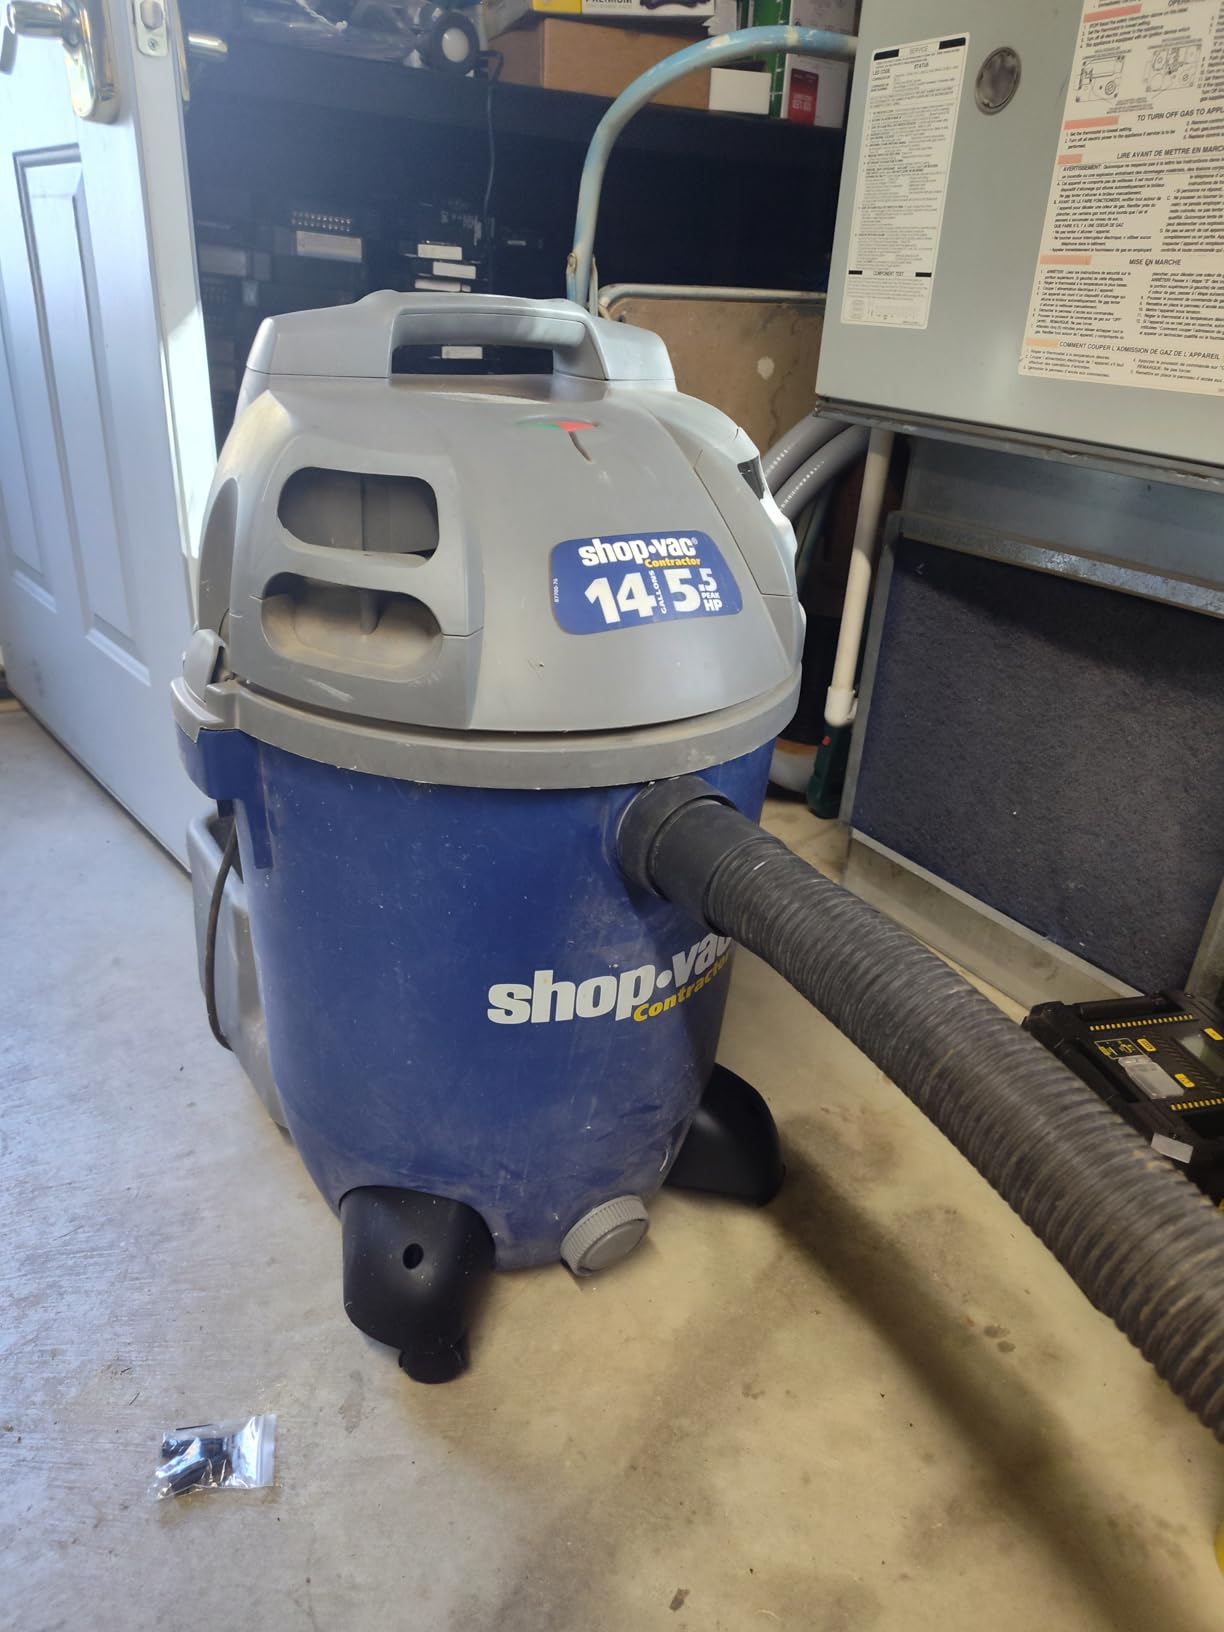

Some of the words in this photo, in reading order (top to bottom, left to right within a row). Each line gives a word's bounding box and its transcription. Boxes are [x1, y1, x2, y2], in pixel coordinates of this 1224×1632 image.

[1137, 113, 1146, 122] TO
[1147, 112, 1165, 121] TURN
[1166, 110, 1179, 119] OFF
[1180, 109, 1194, 118] GAS
[1195, 108, 1206, 116] TO
[1117, 151, 1130, 160] LIRE
[1131, 150, 1153, 159] AVANT
[1154, 149, 1163, 157] DE
[1164, 148, 1191, 157] METTRE
[1191, 146, 1201, 154] EN
[1128, 259, 1143, 267] MISE
[1144, 259, 1153, 268] EN
[1154, 259, 1181, 267] MARCHE
[1059, 341, 1087, 349] COMMENT
[1087, 342, 1111, 351] COUPER
[1160, 349, 1173, 357] GAZ
[1184, 351, 1220, 360] L'APPAREIL
[644, 558, 701, 568] Contractor
[584, 572, 657, 625] 14
[648, 569, 668, 615] GALLONS
[704, 599, 723, 612] HP
